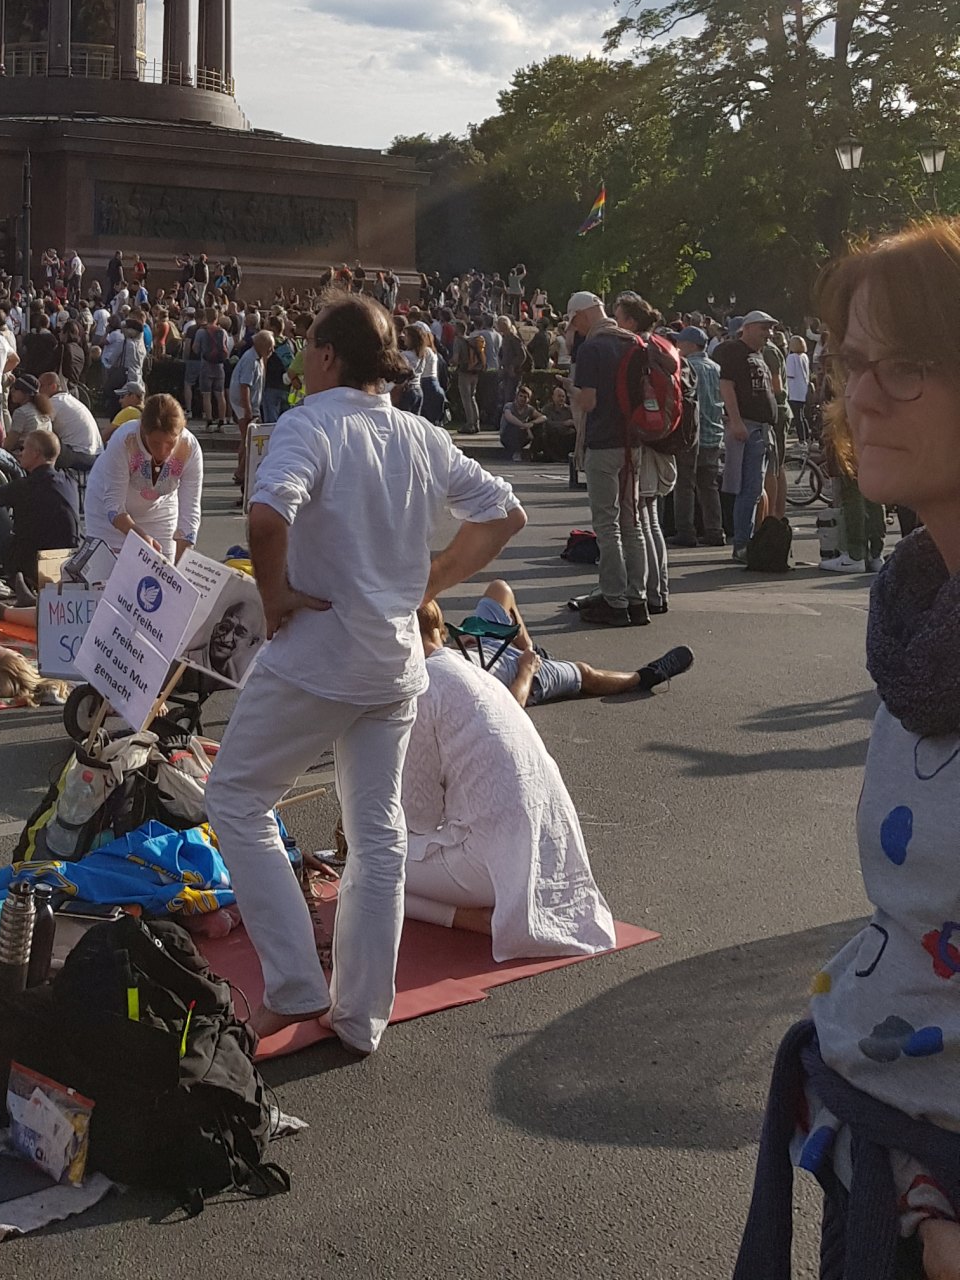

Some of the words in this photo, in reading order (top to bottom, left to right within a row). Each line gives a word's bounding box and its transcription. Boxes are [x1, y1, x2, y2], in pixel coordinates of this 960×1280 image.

[138, 548, 151, 564] Für
[151, 560, 182, 594] Frieden
[48, 600, 99, 625] MASKE
[118, 594, 133, 612] und
[133, 608, 163, 643] Freiheit
[94, 636, 113, 658] wird
[112, 656, 128, 674] aus
[129, 669, 148, 694] Mut
[112, 626, 144, 664] Freiheit
[94, 663, 132, 702] gemacht
